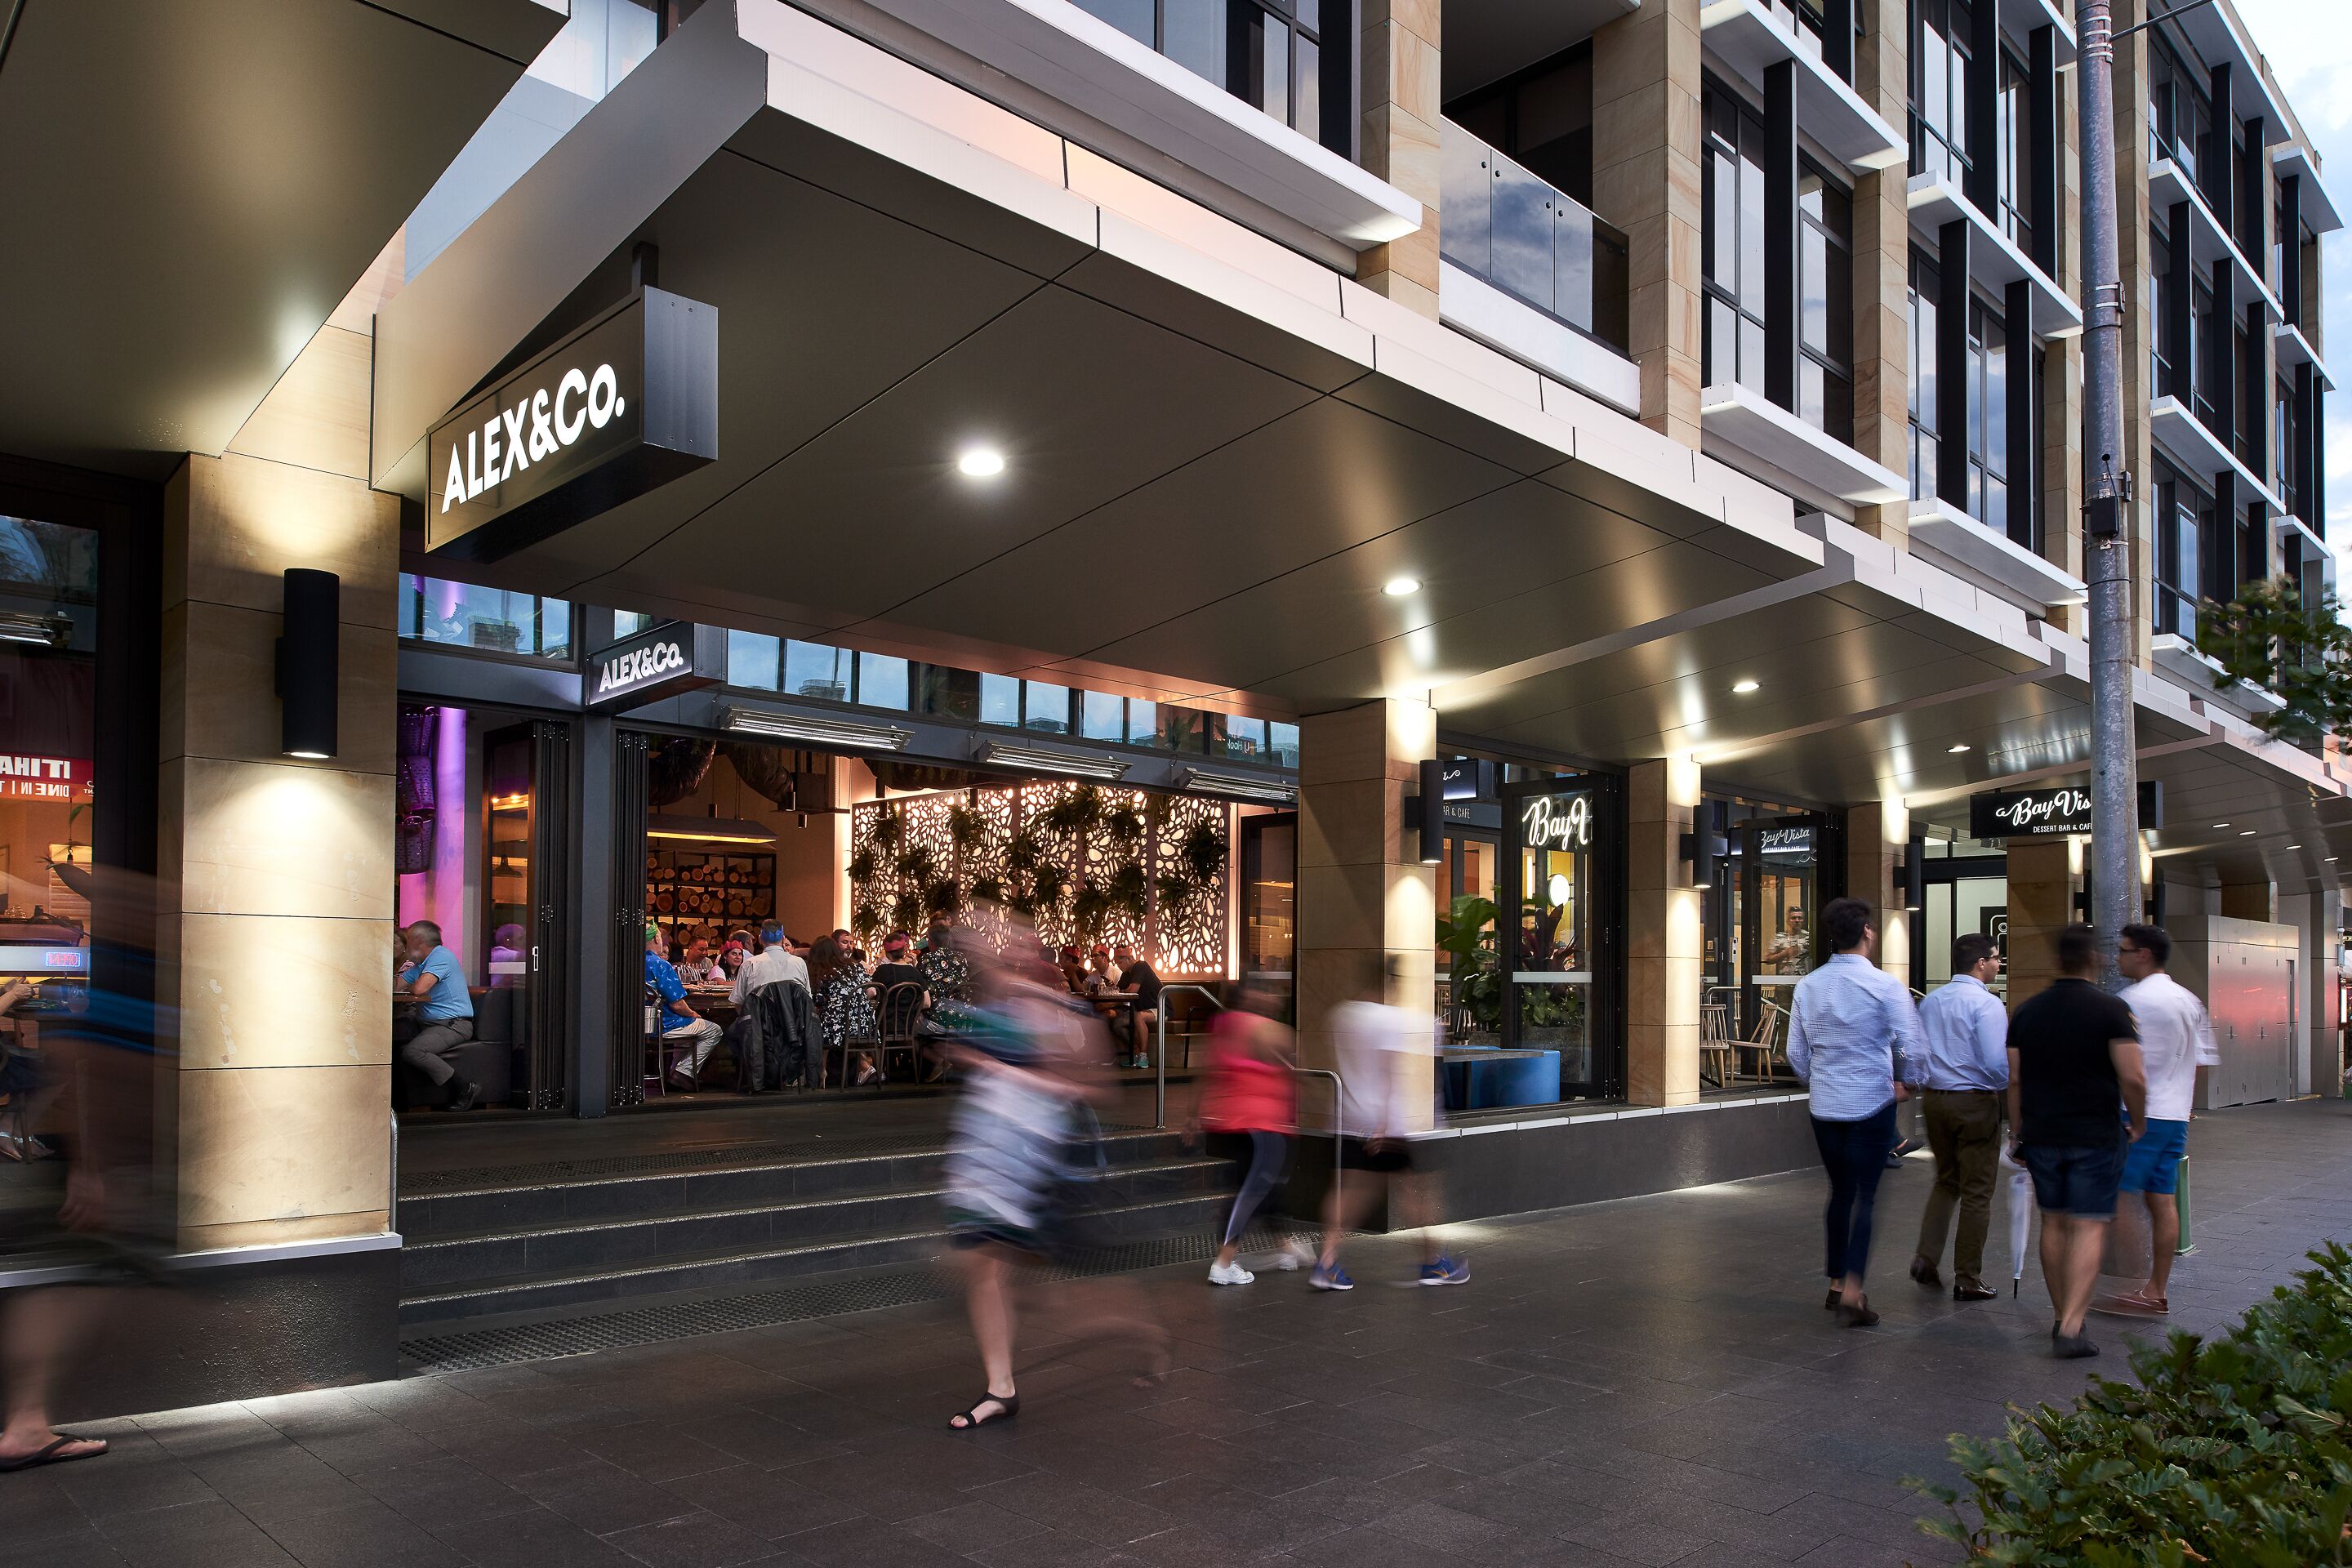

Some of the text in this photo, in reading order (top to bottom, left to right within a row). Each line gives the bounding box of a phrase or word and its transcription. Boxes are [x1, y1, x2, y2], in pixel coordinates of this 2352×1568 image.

[1451, 807, 1457, 817] &
[1457, 807, 1471, 819] CAFE
[1996, 791, 2091, 826] Bay Vis
[1521, 796, 1573, 851] Bay
[2033, 825, 2057, 833] DESSERT
[2058, 824, 2071, 832] BAR
[1780, 828, 1810, 844] Vista
